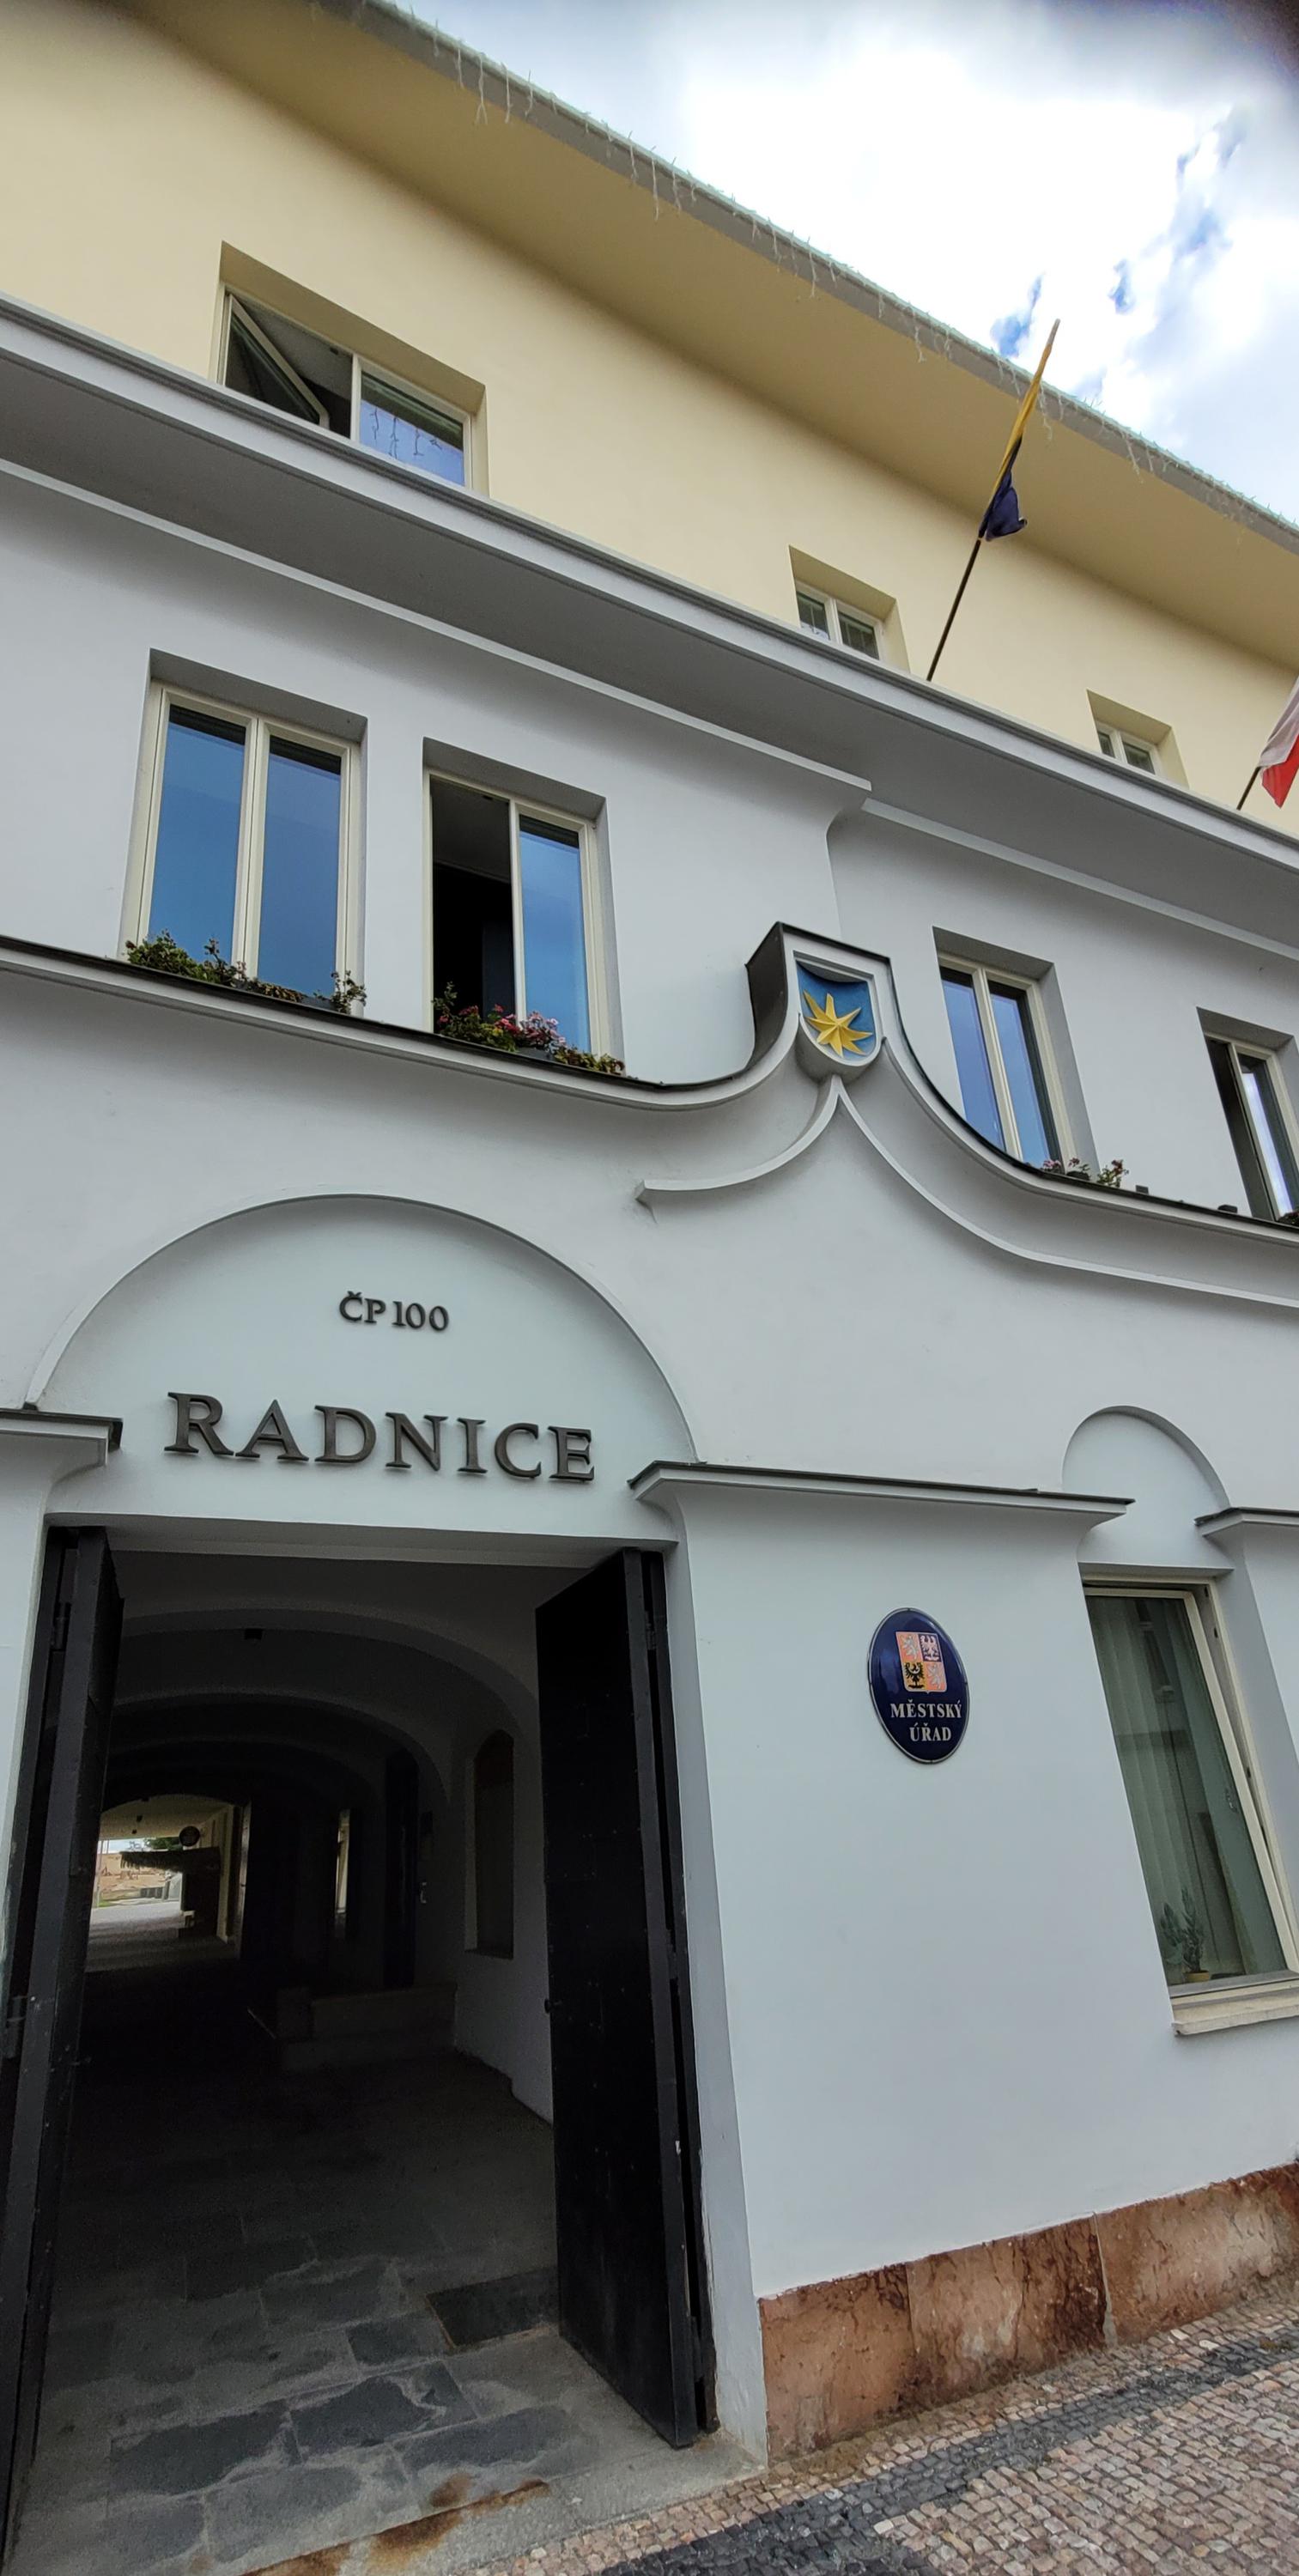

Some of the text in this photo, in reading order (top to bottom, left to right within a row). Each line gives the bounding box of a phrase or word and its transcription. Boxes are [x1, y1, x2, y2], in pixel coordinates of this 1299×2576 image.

[339, 1291, 450, 1332] ČP 100
[164, 1392, 595, 1482] RADNICE
[889, 1698, 962, 1718] MĚSTSKÝ
[909, 1722, 952, 1741] ÚŘAD
